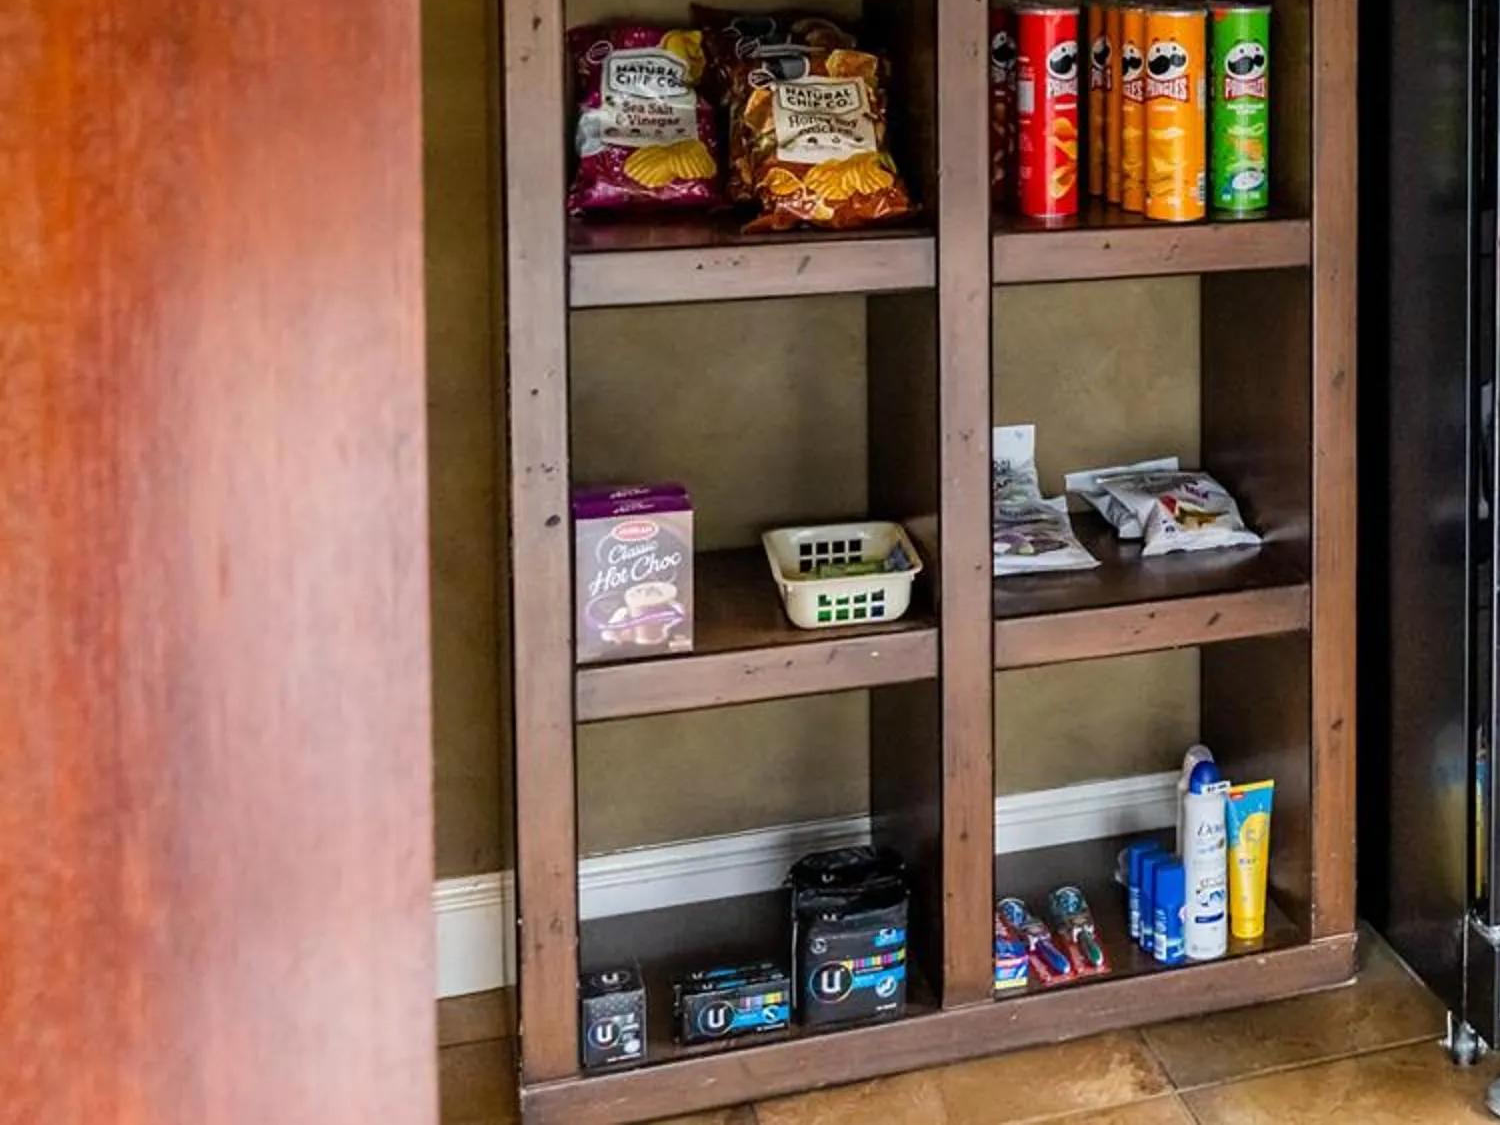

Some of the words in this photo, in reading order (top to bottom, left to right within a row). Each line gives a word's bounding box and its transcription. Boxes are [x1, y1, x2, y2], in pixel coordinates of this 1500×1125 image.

[588, 566, 629, 596] Hot
[631, 551, 682, 581] Choc
[822, 970, 841, 993] U
[708, 1007, 725, 1028] U
[597, 1024, 612, 1043] U
